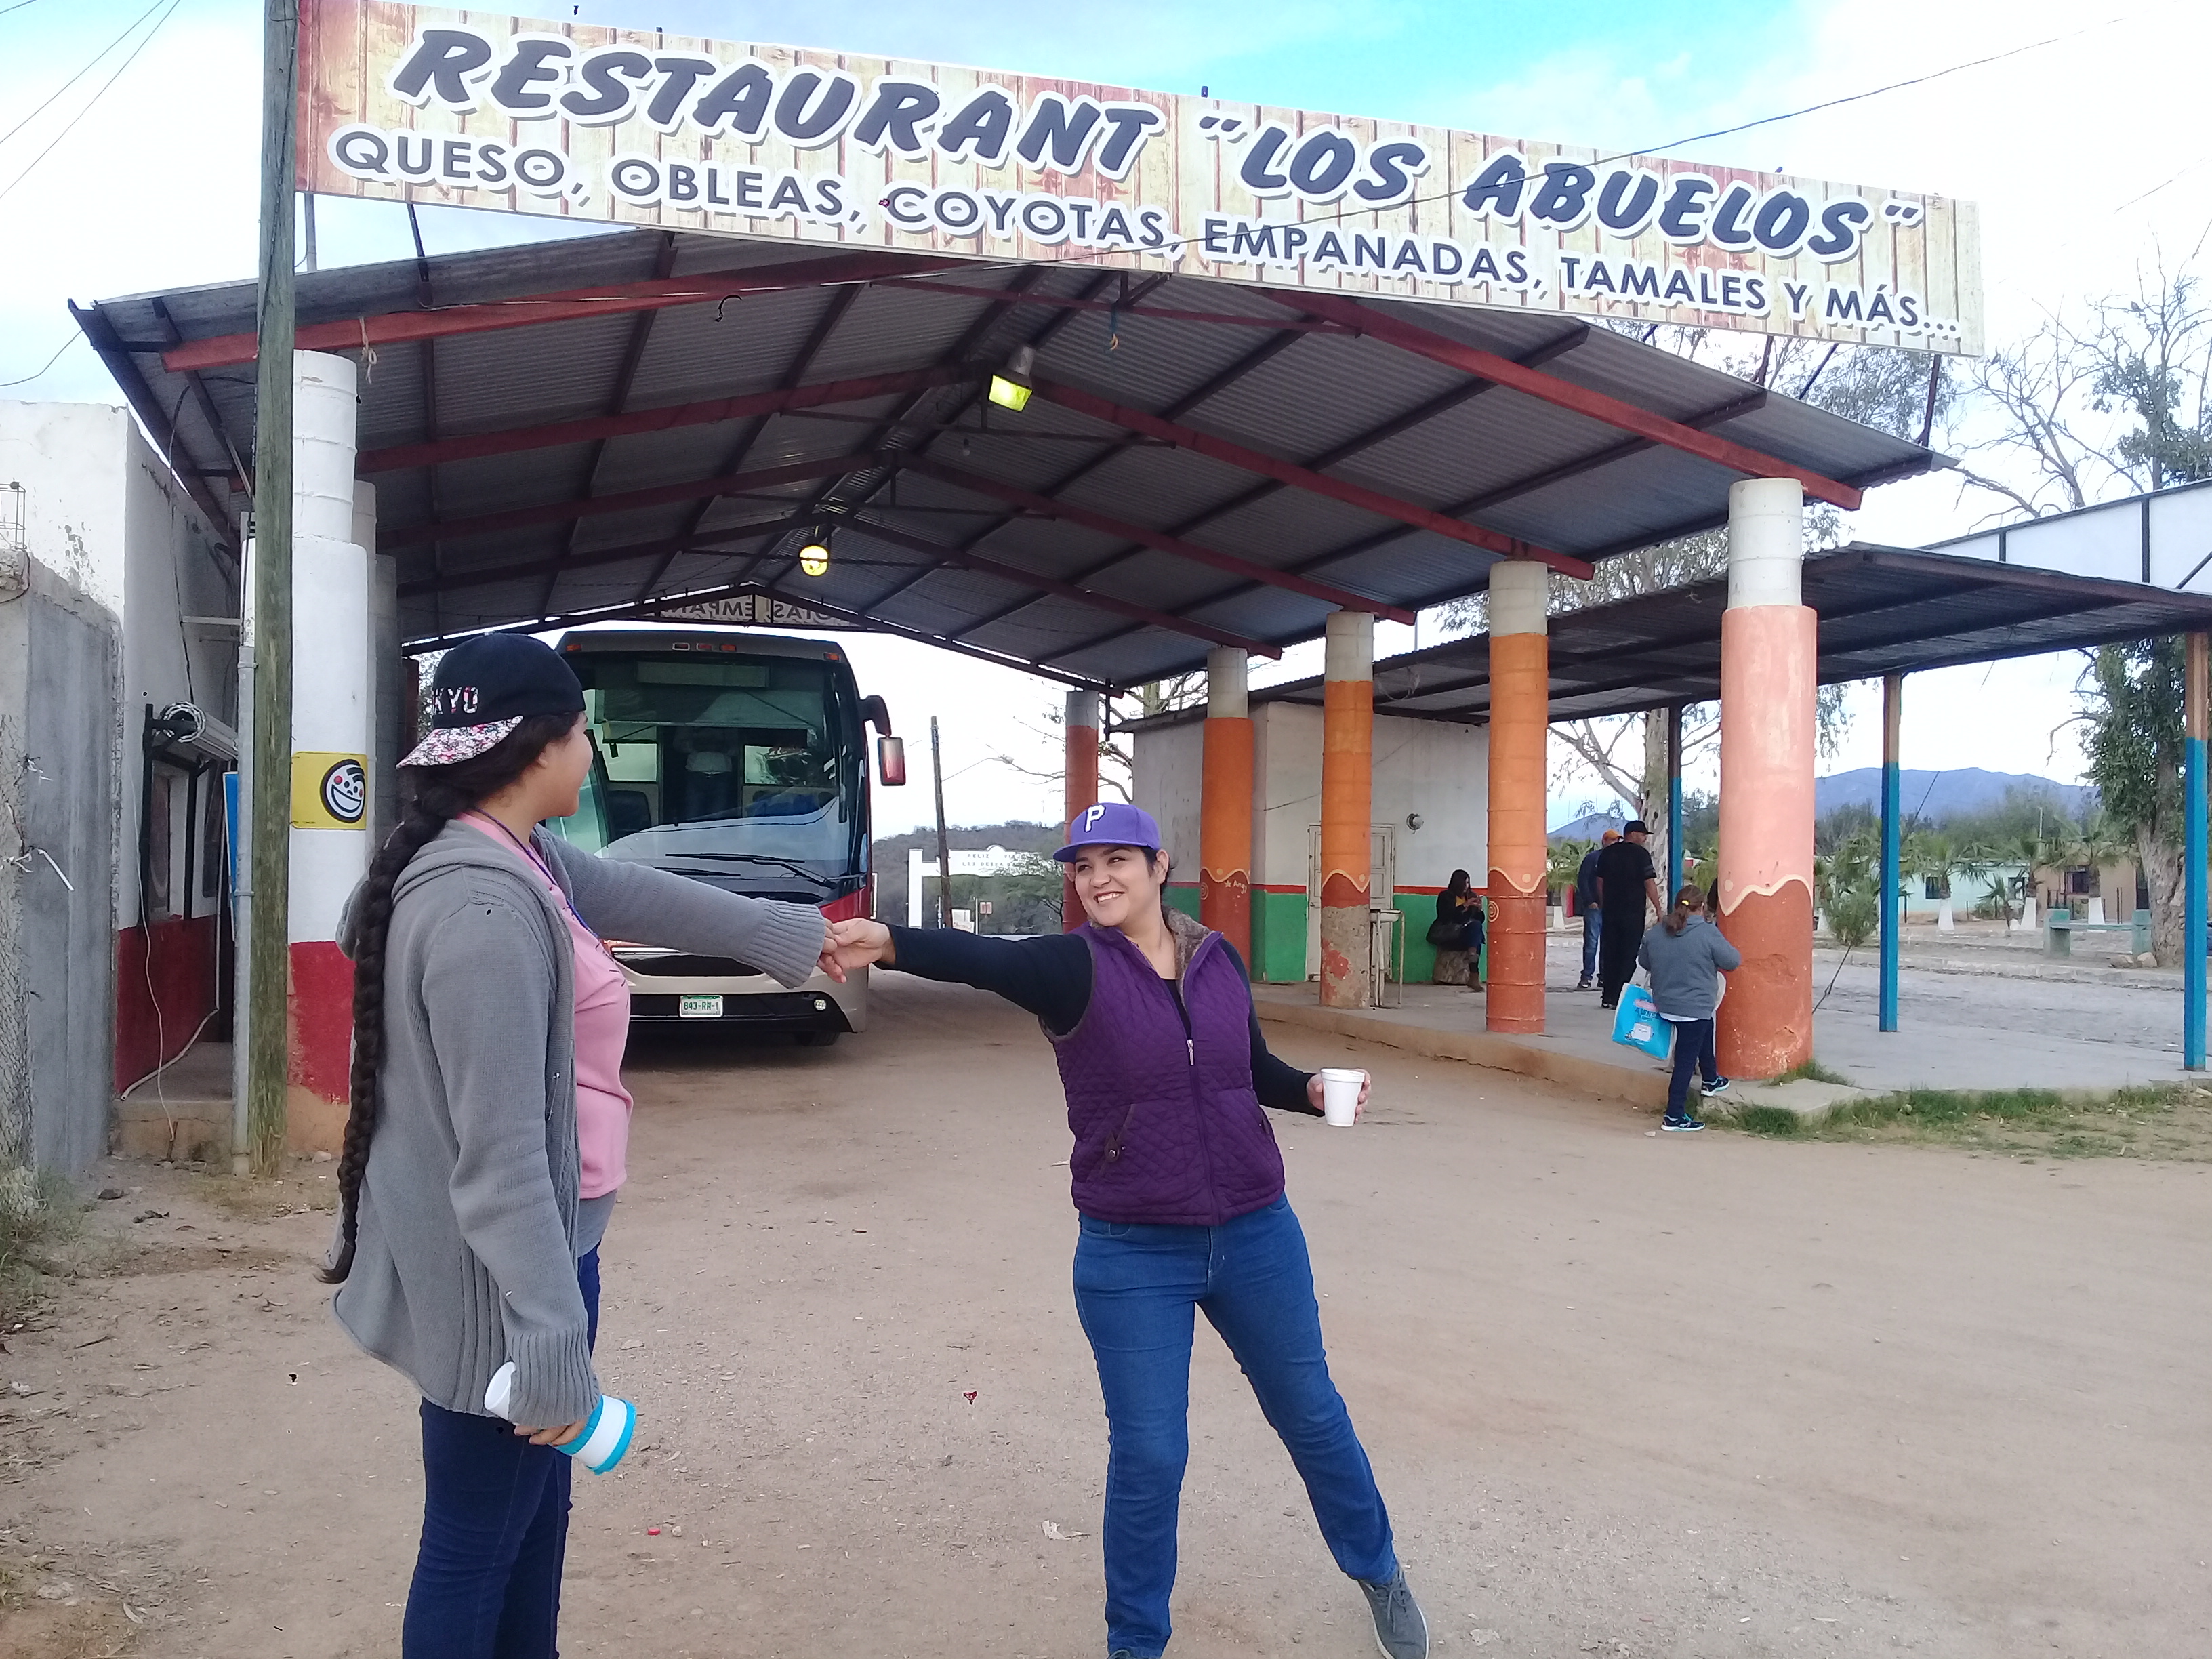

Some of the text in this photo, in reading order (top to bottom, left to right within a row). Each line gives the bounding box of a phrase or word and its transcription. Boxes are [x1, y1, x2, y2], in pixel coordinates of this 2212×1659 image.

[335, 131, 1957, 332] QUESO, OBLEAS, COYOTAS, EMPANADAS, TAMALES Y MÁS...
[392, 30, 1919, 255] RESTAURANT "LOS ABUELOS"
[1084, 804, 1106, 832] P
